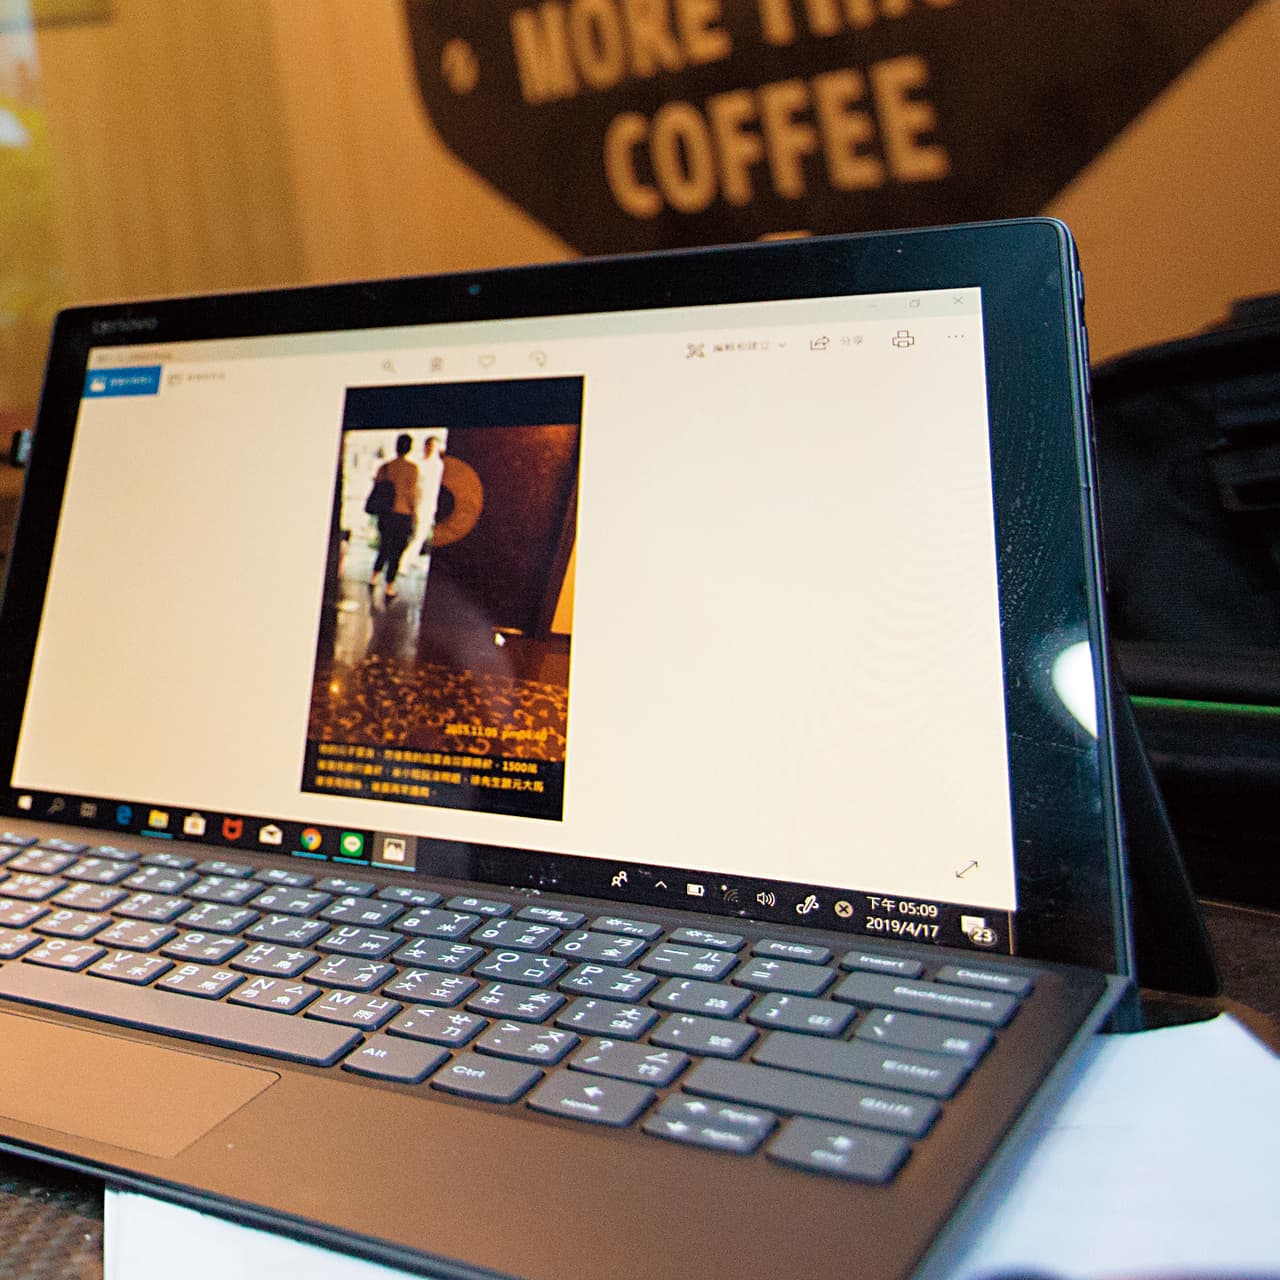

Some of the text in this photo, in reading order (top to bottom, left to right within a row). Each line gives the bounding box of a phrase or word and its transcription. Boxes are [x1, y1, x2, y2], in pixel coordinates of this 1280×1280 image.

[603, 55, 948, 218] COFFEE
[866, 895, 938, 917] 下午 05:09
[866, 916, 939, 938] 2019/4/17
[972, 929, 993, 942] 23
[363, 1048, 386, 1057] Alt
[453, 1066, 485, 1077] Ctrl
